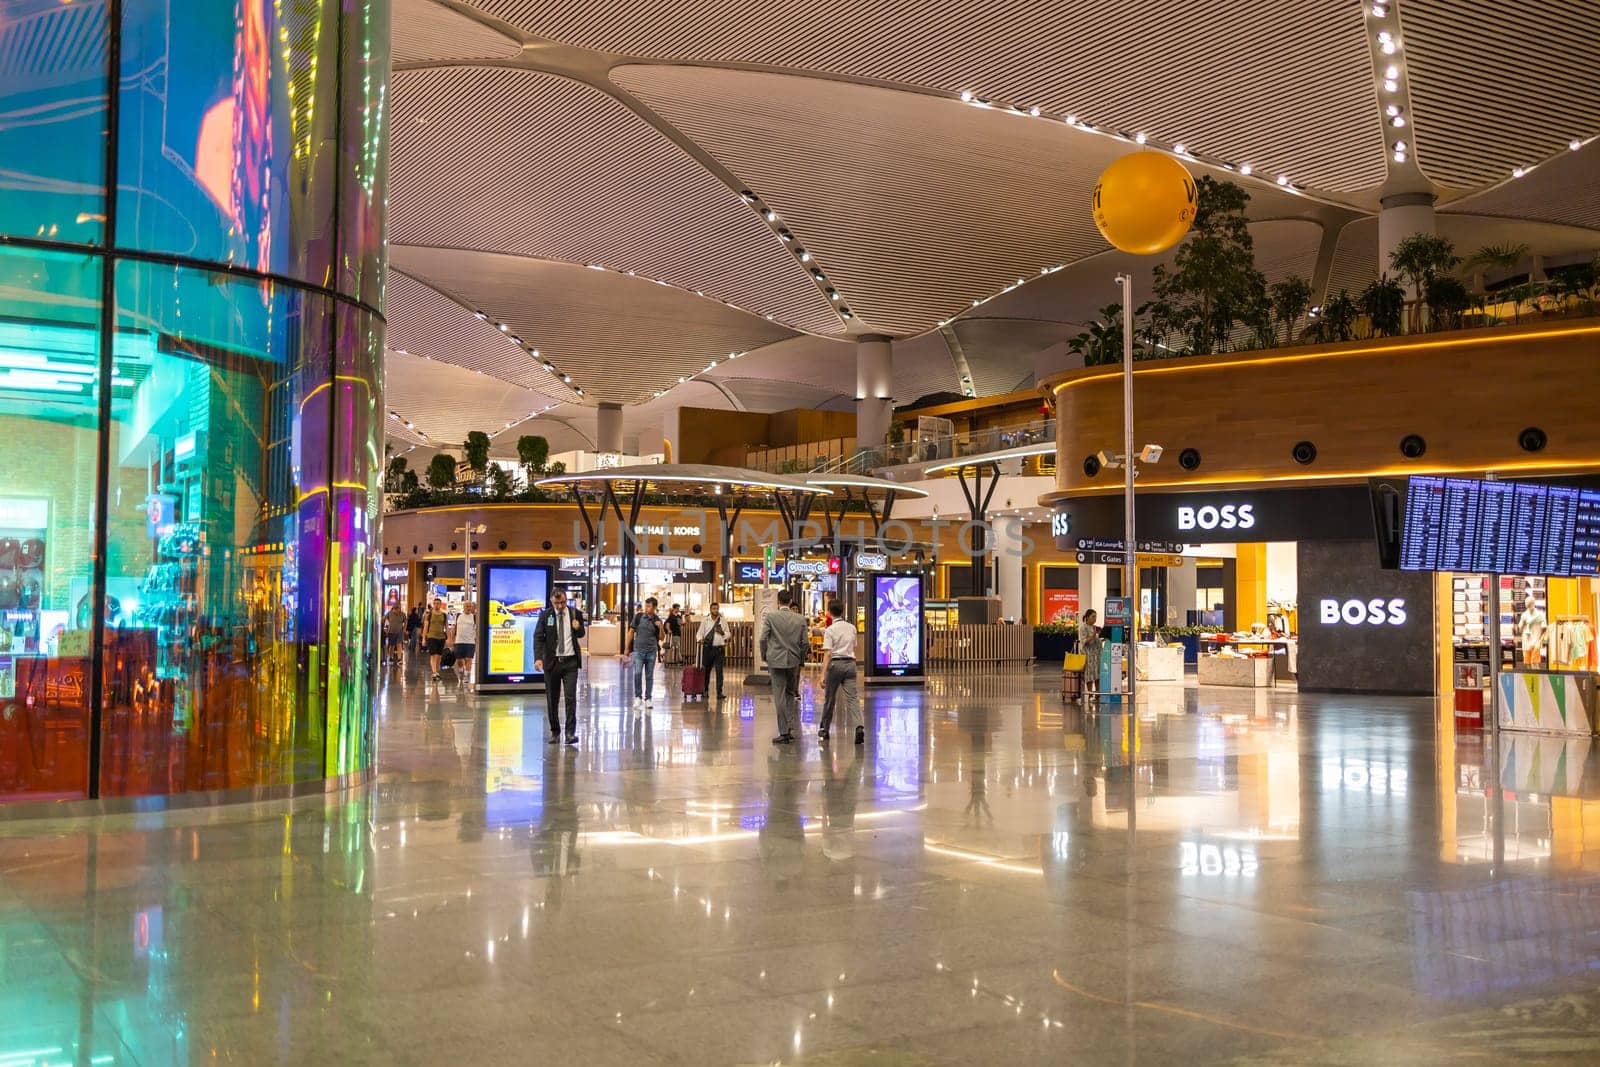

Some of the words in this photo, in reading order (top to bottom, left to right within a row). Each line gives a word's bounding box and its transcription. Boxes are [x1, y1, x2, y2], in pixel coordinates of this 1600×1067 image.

[1178, 504, 1256, 530] BOSS
[634, 525, 672, 535] MICHAE
[673, 526, 701, 536] KORS
[1320, 599, 1407, 625] BOSS
